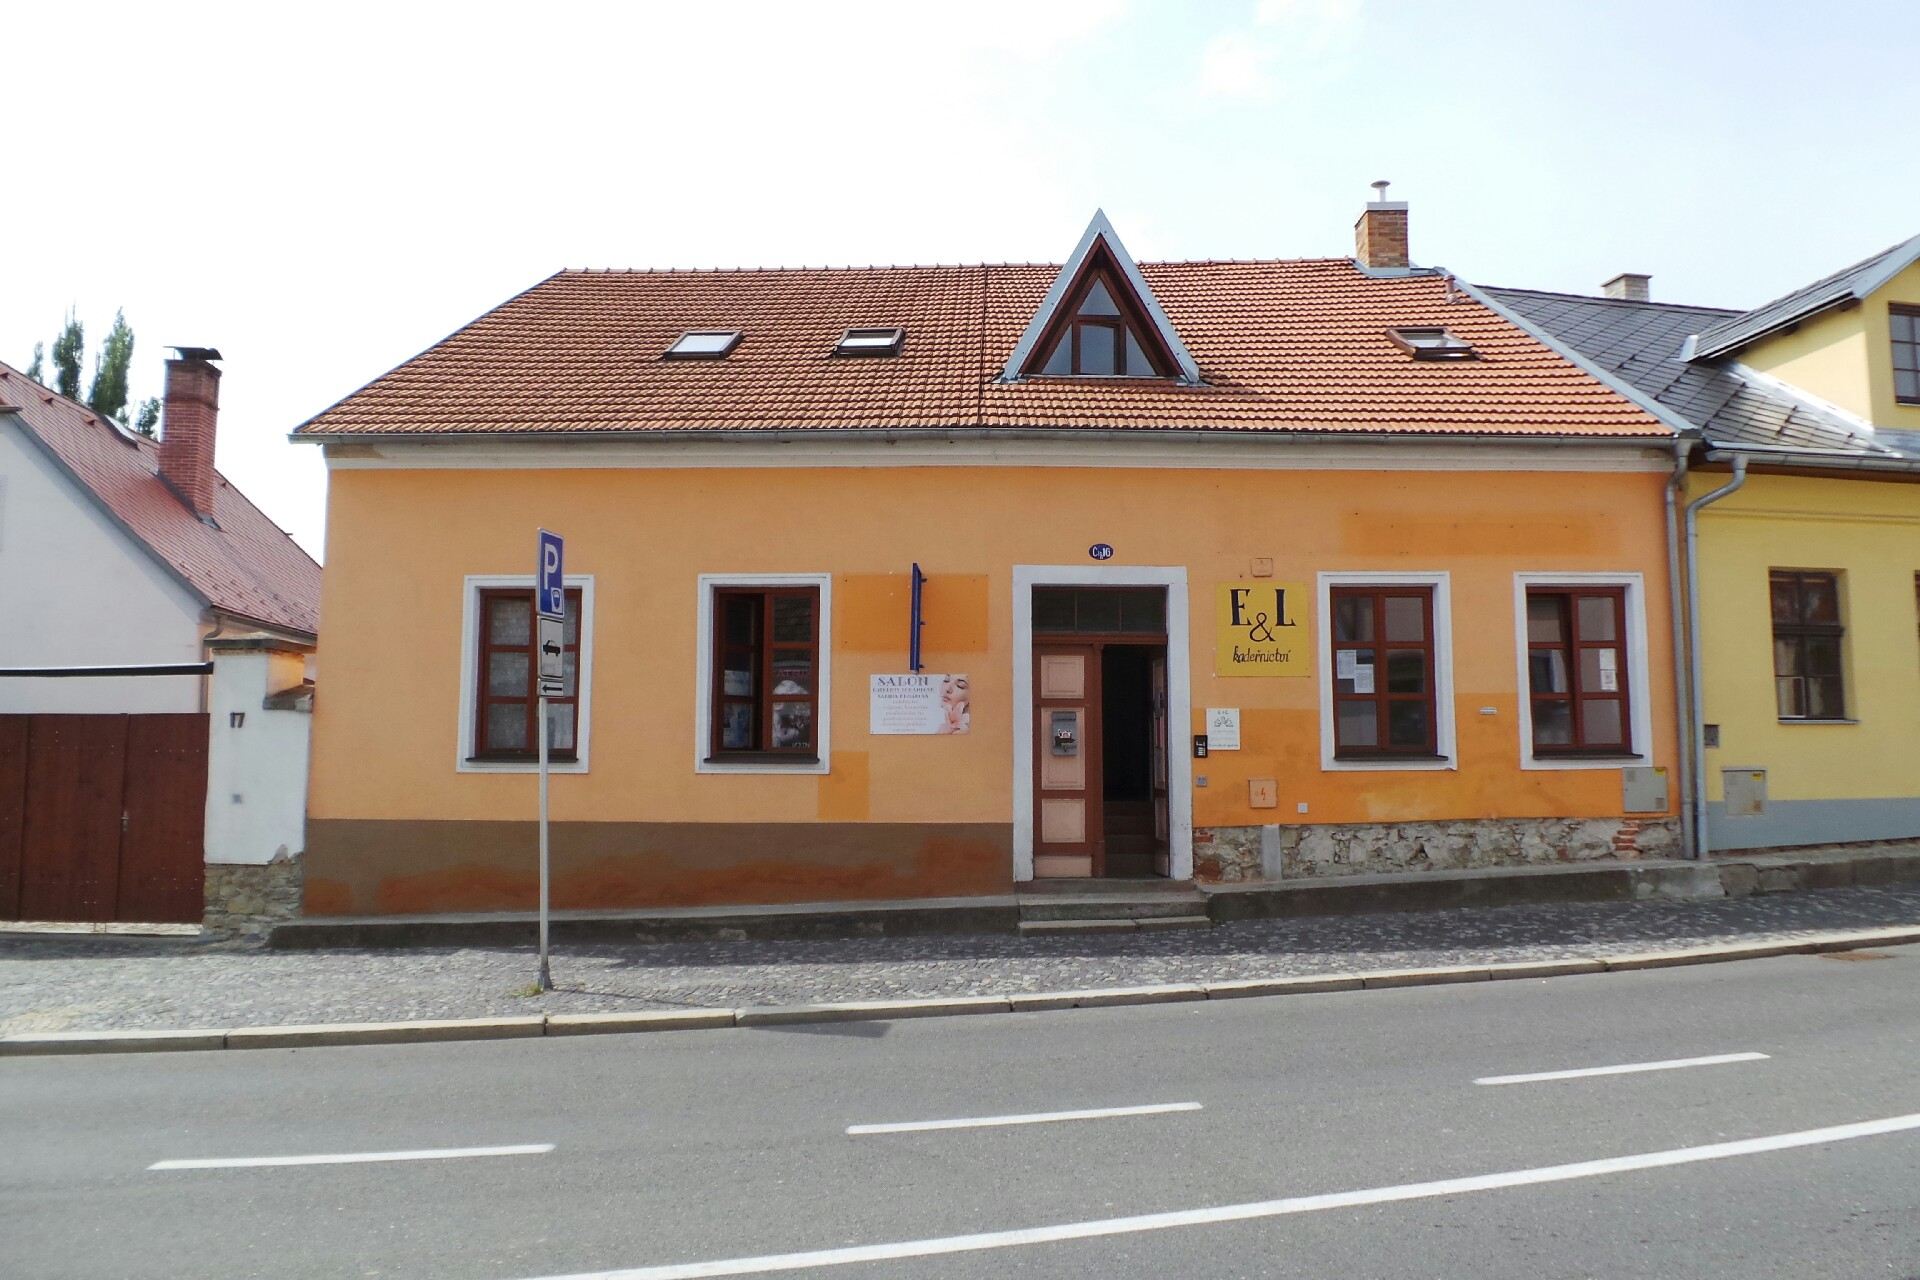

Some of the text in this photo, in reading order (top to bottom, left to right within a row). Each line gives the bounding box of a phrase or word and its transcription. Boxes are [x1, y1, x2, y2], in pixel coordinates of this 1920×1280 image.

[544, 543, 558, 589] P
[1249, 612, 1276, 642] &
[1275, 588, 1297, 627] L
[877, 676, 929, 687] SALON
[229, 711, 246, 729] 17
